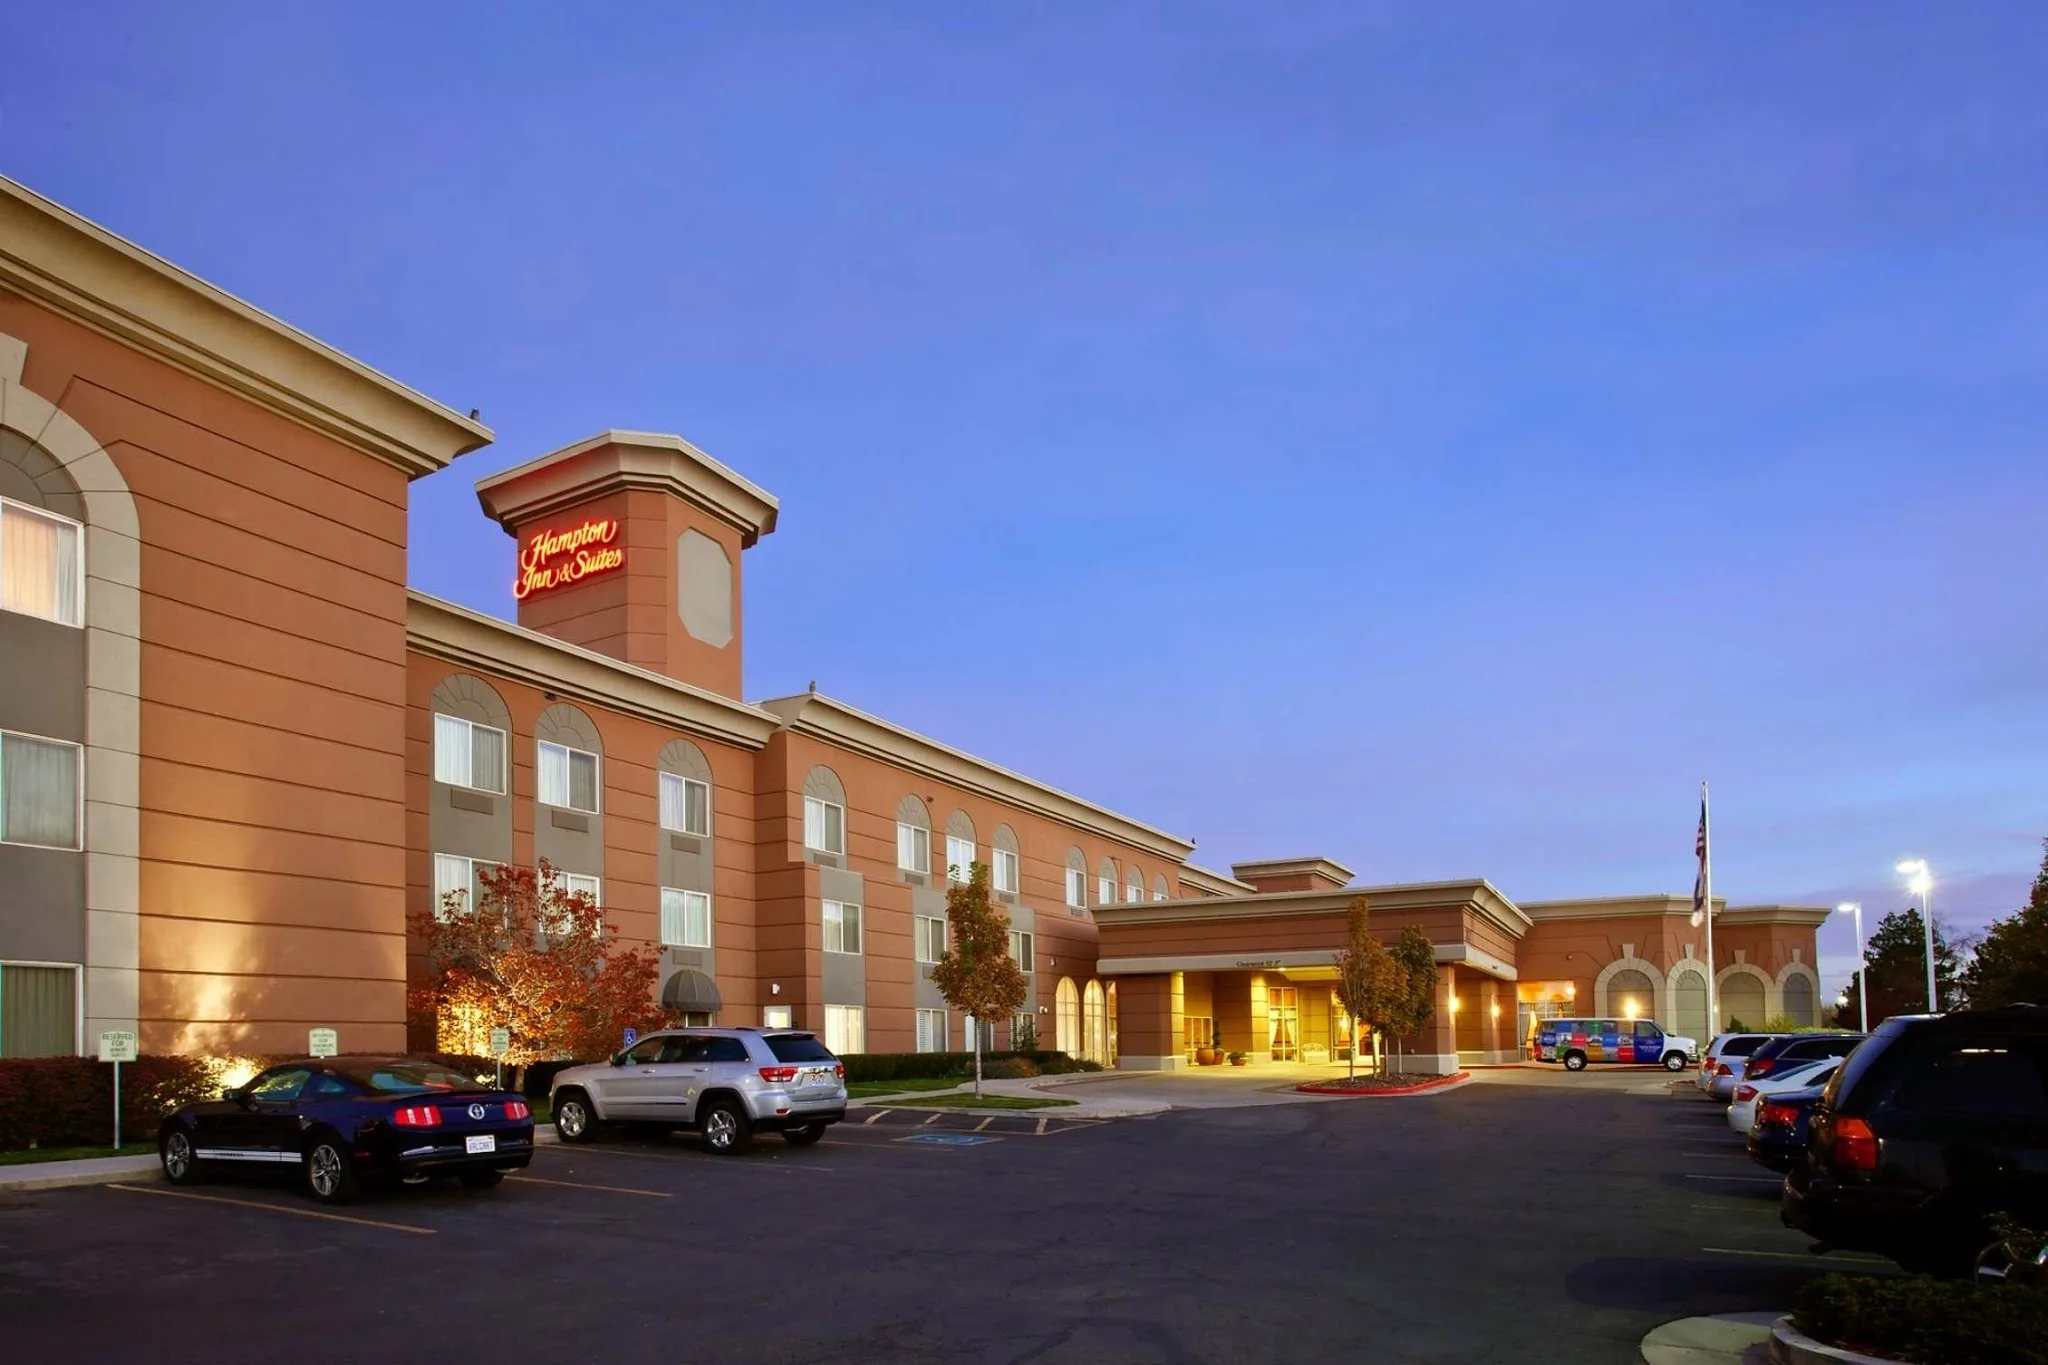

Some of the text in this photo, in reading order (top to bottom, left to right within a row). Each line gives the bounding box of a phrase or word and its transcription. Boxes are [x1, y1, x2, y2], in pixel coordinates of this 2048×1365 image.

[521, 520, 617, 570] Hampton
[513, 548, 623, 599] Inn & Suites
